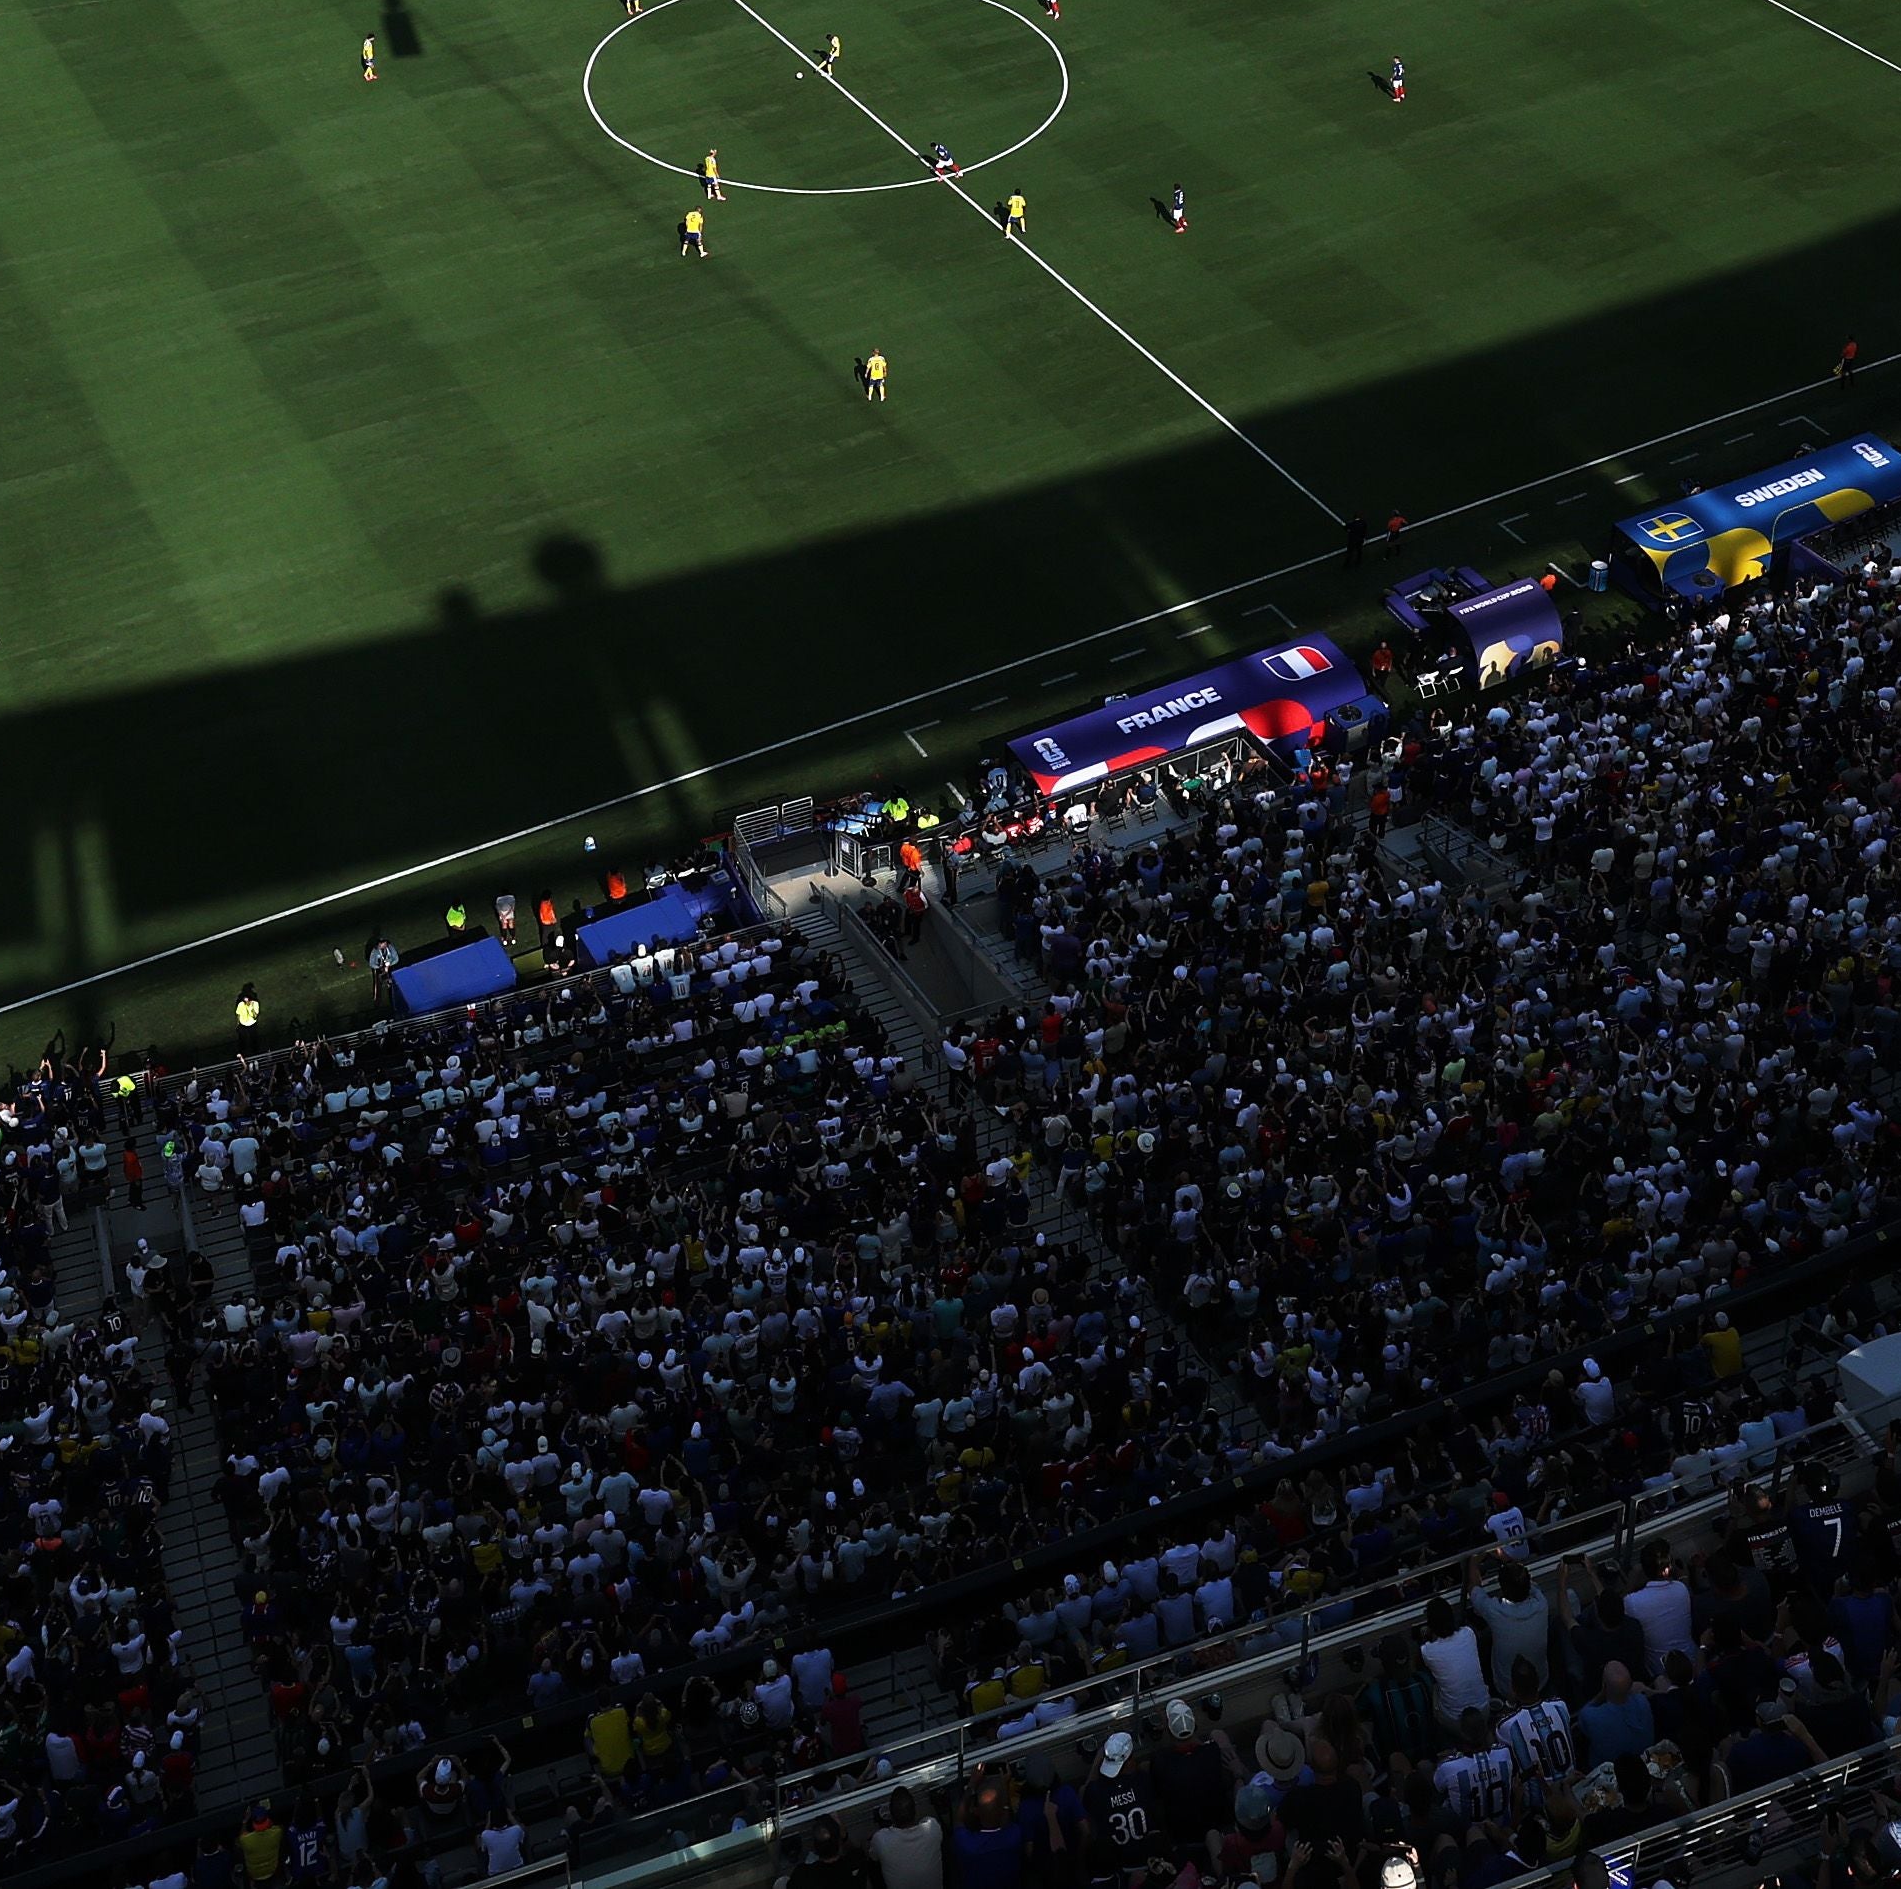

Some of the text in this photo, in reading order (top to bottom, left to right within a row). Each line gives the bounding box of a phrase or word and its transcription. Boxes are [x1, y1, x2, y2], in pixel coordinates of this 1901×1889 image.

[1734, 468, 1826, 508] SWEDEN
[1510, 584, 1535, 598] 2026
[1116, 685, 1222, 735] FRANCE
[106, 1316, 122, 1332] 10
[1683, 1413, 1703, 1435] 10
[106, 1495, 122, 1508] 10
[1822, 1517, 1845, 1558] 7
[702, 1642, 721, 1657] 10
[1530, 1729, 1572, 1779] 10
[1109, 1790, 1137, 1808] MESSI
[1469, 1778, 1511, 1823] 10
[1107, 1807, 1148, 1845] 30
